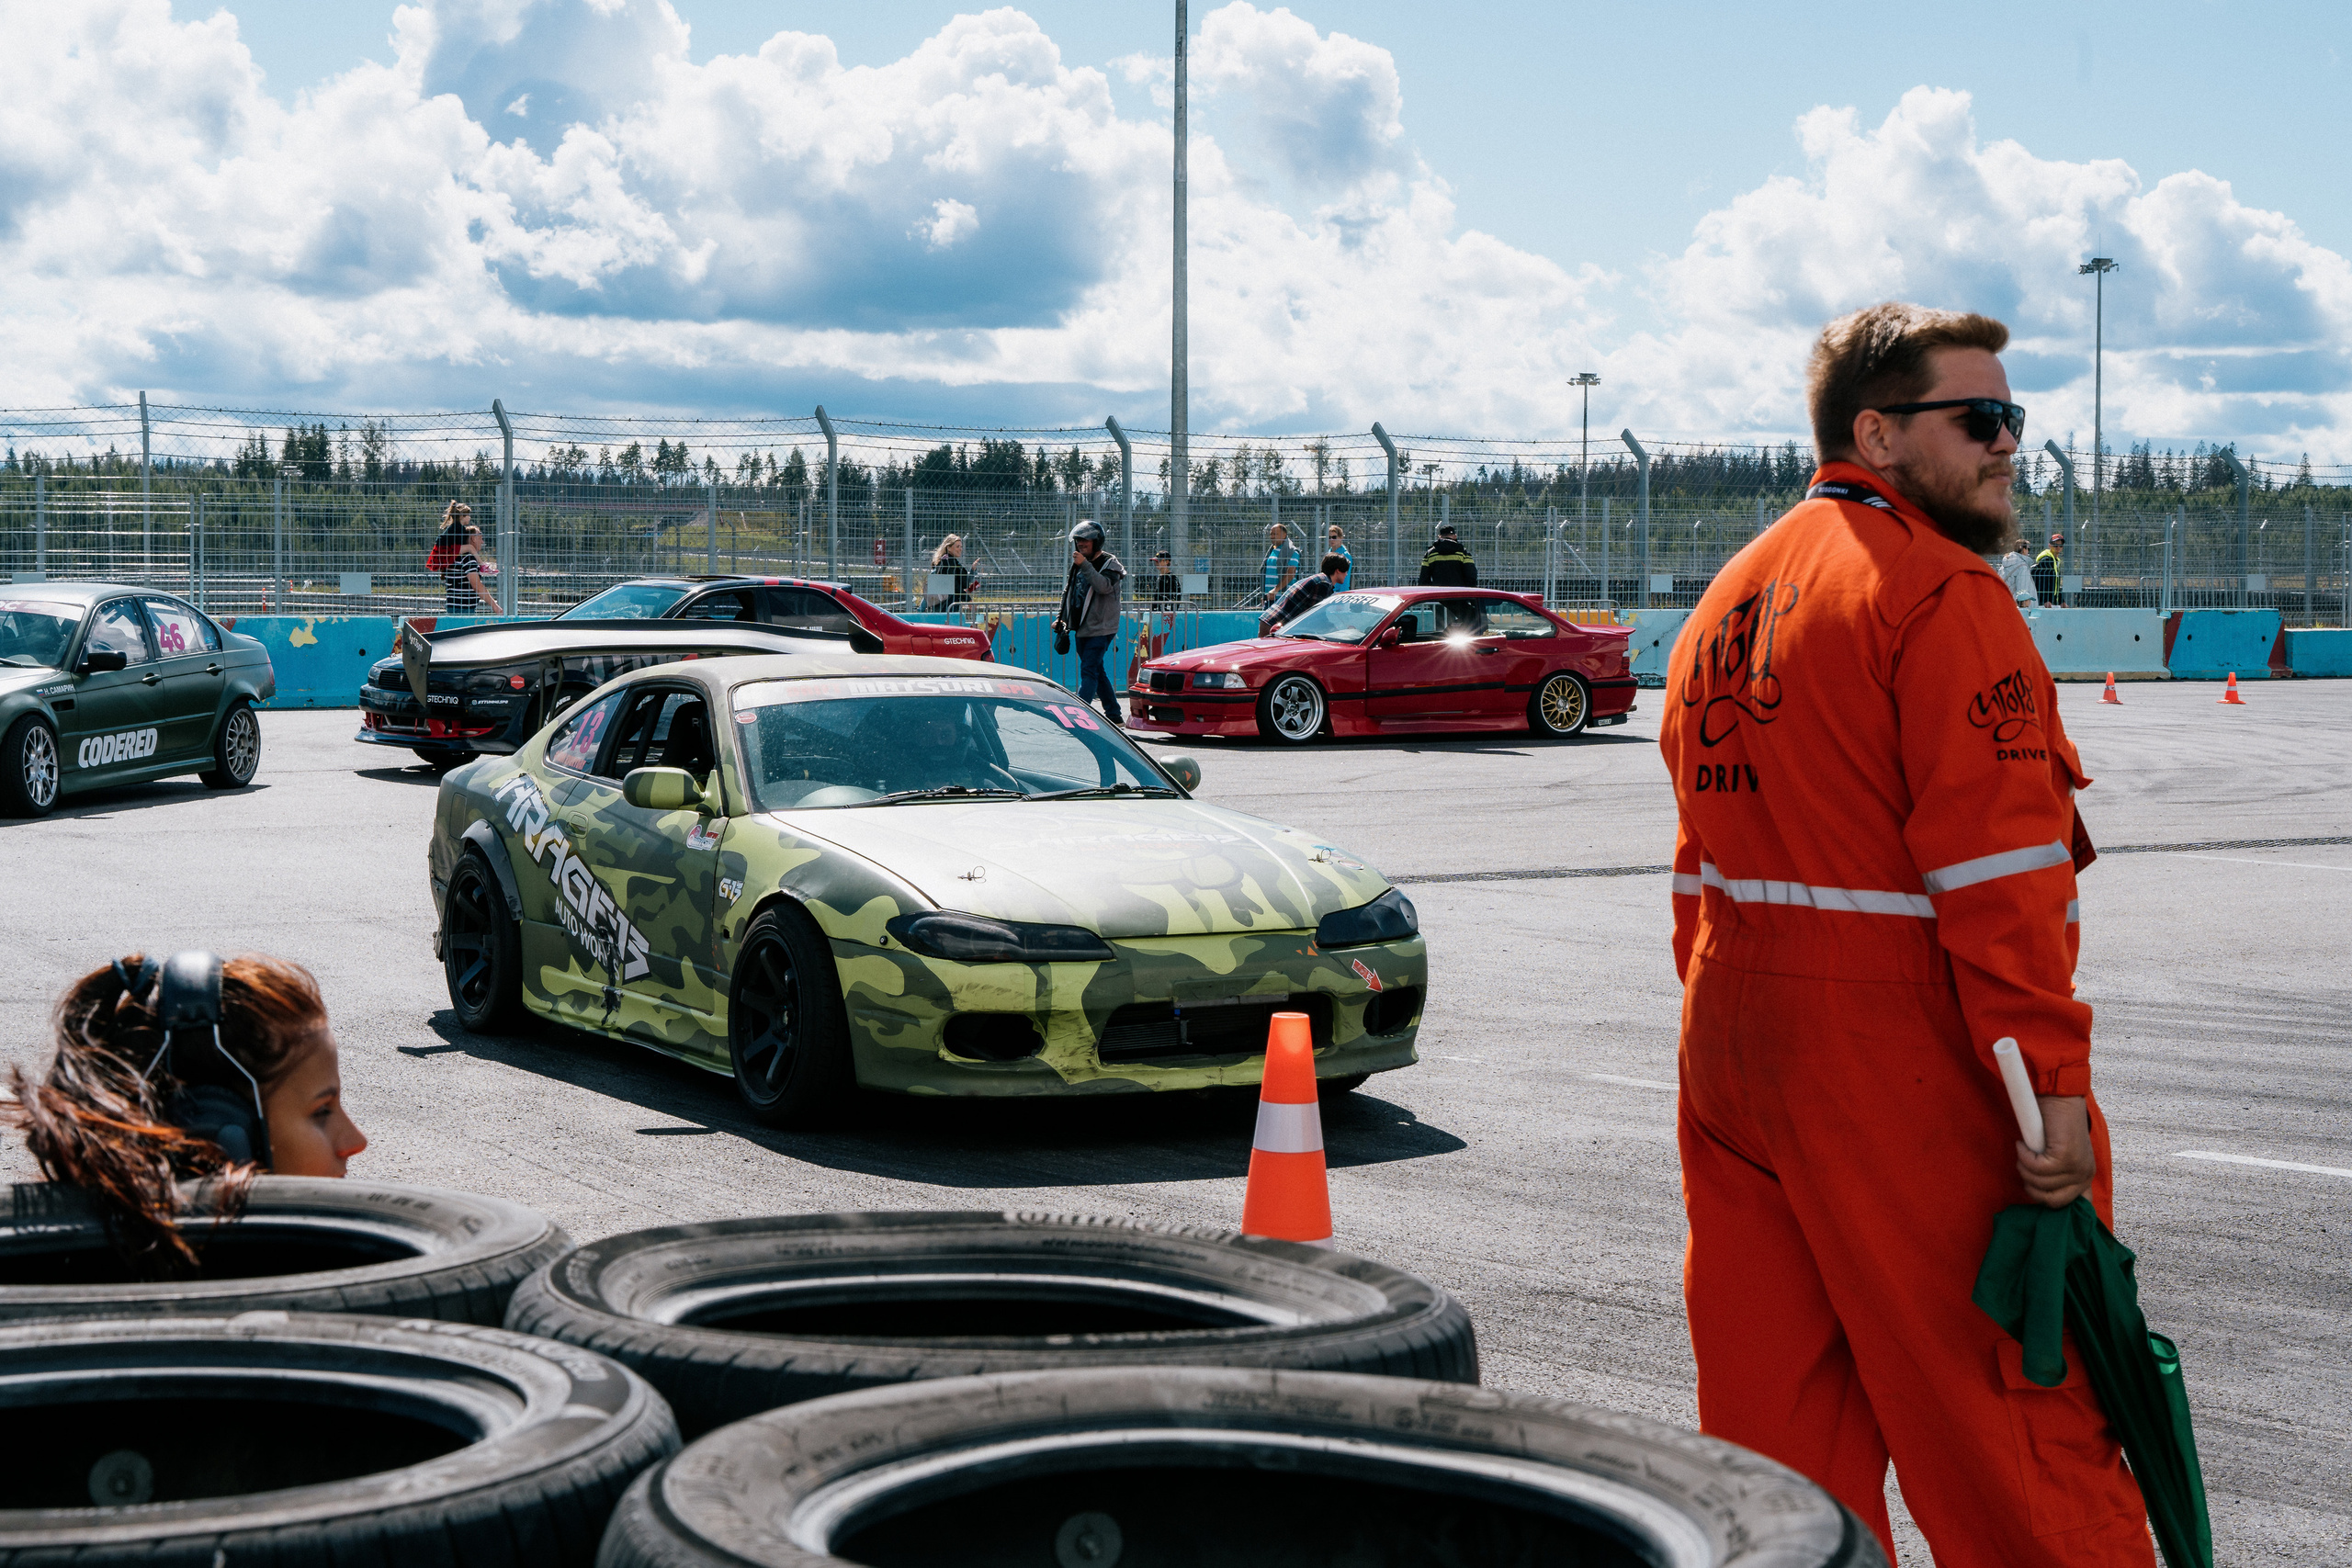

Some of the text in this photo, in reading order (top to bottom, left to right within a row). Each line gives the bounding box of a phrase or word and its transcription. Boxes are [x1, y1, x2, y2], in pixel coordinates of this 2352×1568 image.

[160, 623, 186, 652] 46
[427, 694, 458, 705] GTECHNIQ
[848, 680, 994, 696] MATSURI
[997, 682, 1035, 696] SPB
[571, 710, 605, 753] 13
[1044, 705, 1100, 730] 13
[78, 728, 158, 769] CODERED
[1996, 748, 2048, 761] DRIVE
[1695, 764, 1758, 793] DRIV
[555, 897, 620, 981] AUTO WORS
